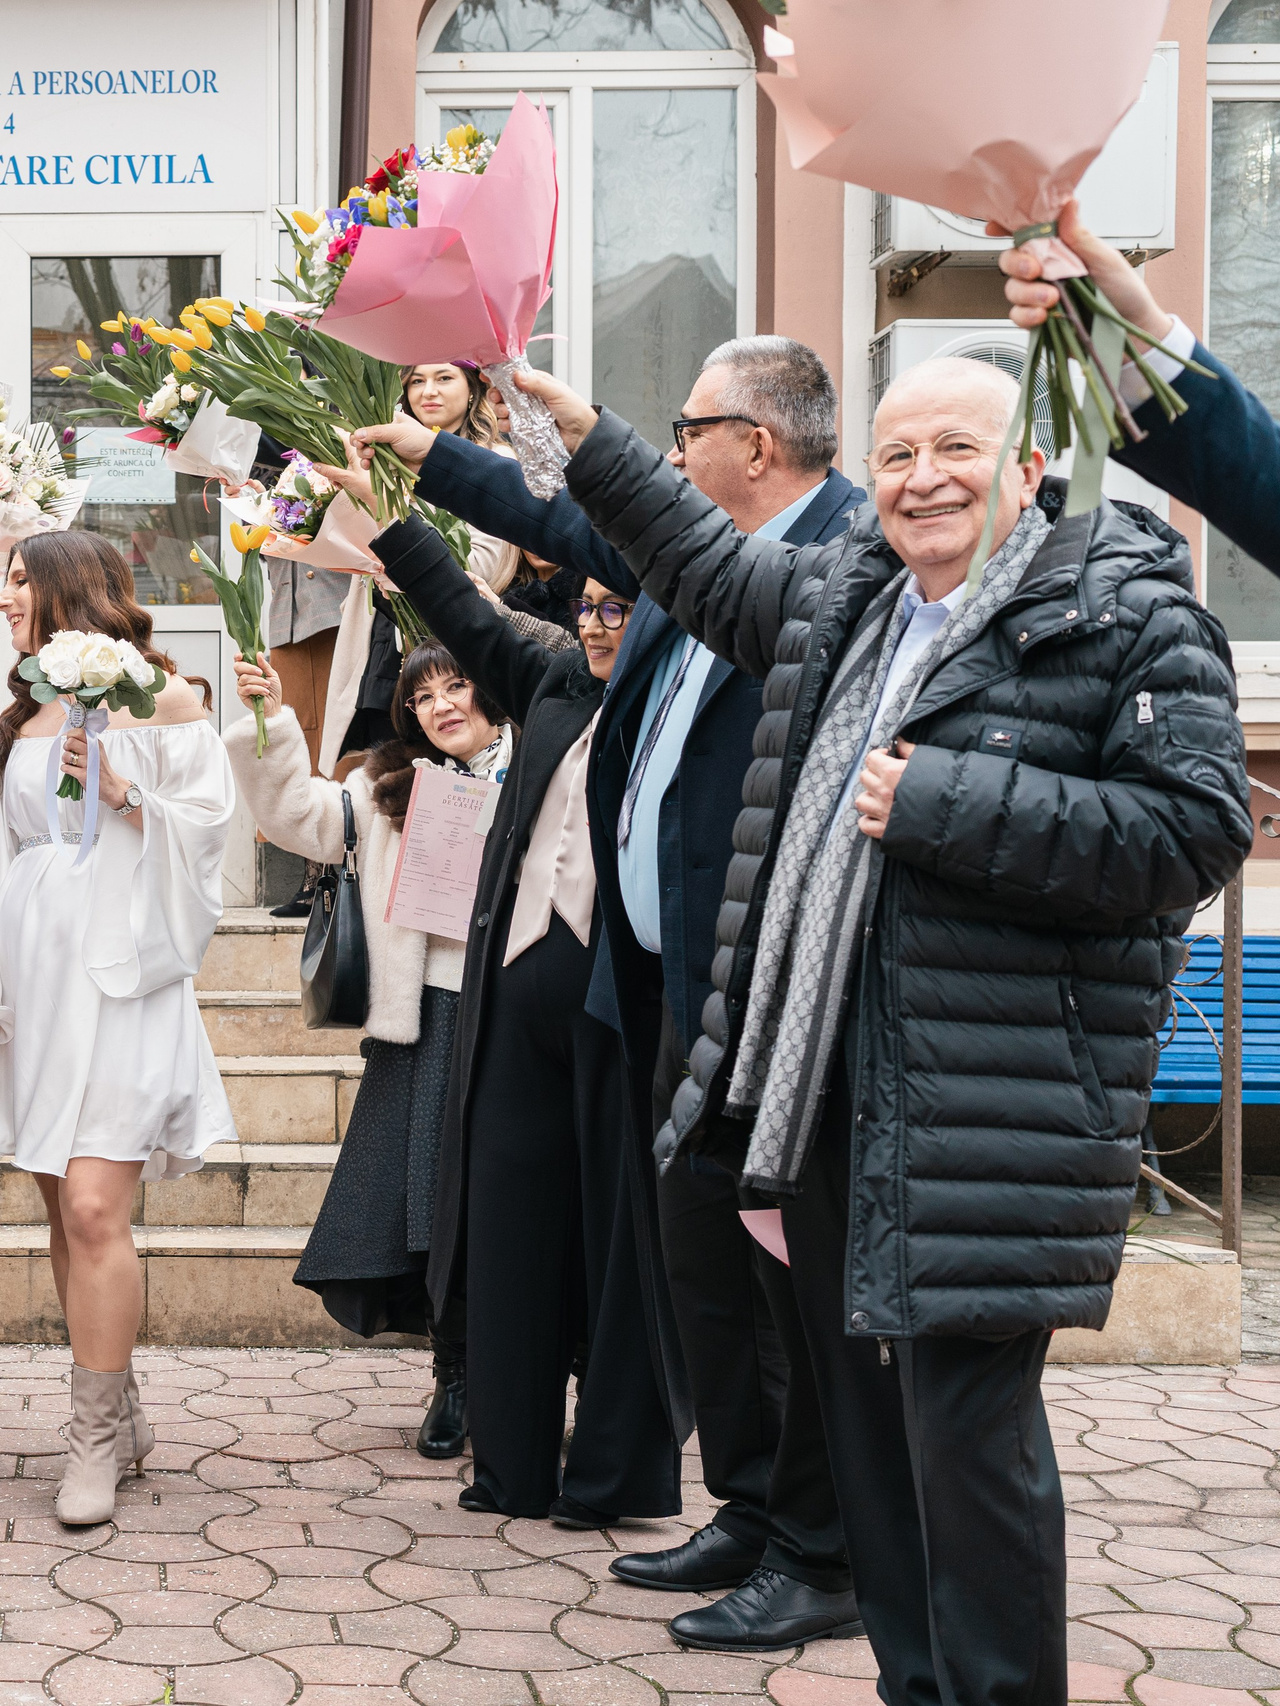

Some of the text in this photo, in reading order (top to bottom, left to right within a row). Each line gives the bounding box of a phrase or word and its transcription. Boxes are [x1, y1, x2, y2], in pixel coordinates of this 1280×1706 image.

[7, 71, 25, 96] A
[33, 69, 219, 95] PERSOANELOR
[3, 113, 16, 135] 4
[84, 153, 215, 185] CIVILA
[100, 448, 152, 456] ESTE INTERZIS
[103, 459, 112, 467] SE
[113, 459, 144, 467] ARUNCA
[145, 459, 156, 467] CU
[107, 469, 144, 477] CONFETTI
[442, 798, 452, 806] DE
[447, 794, 485, 807] CERTIFIC
